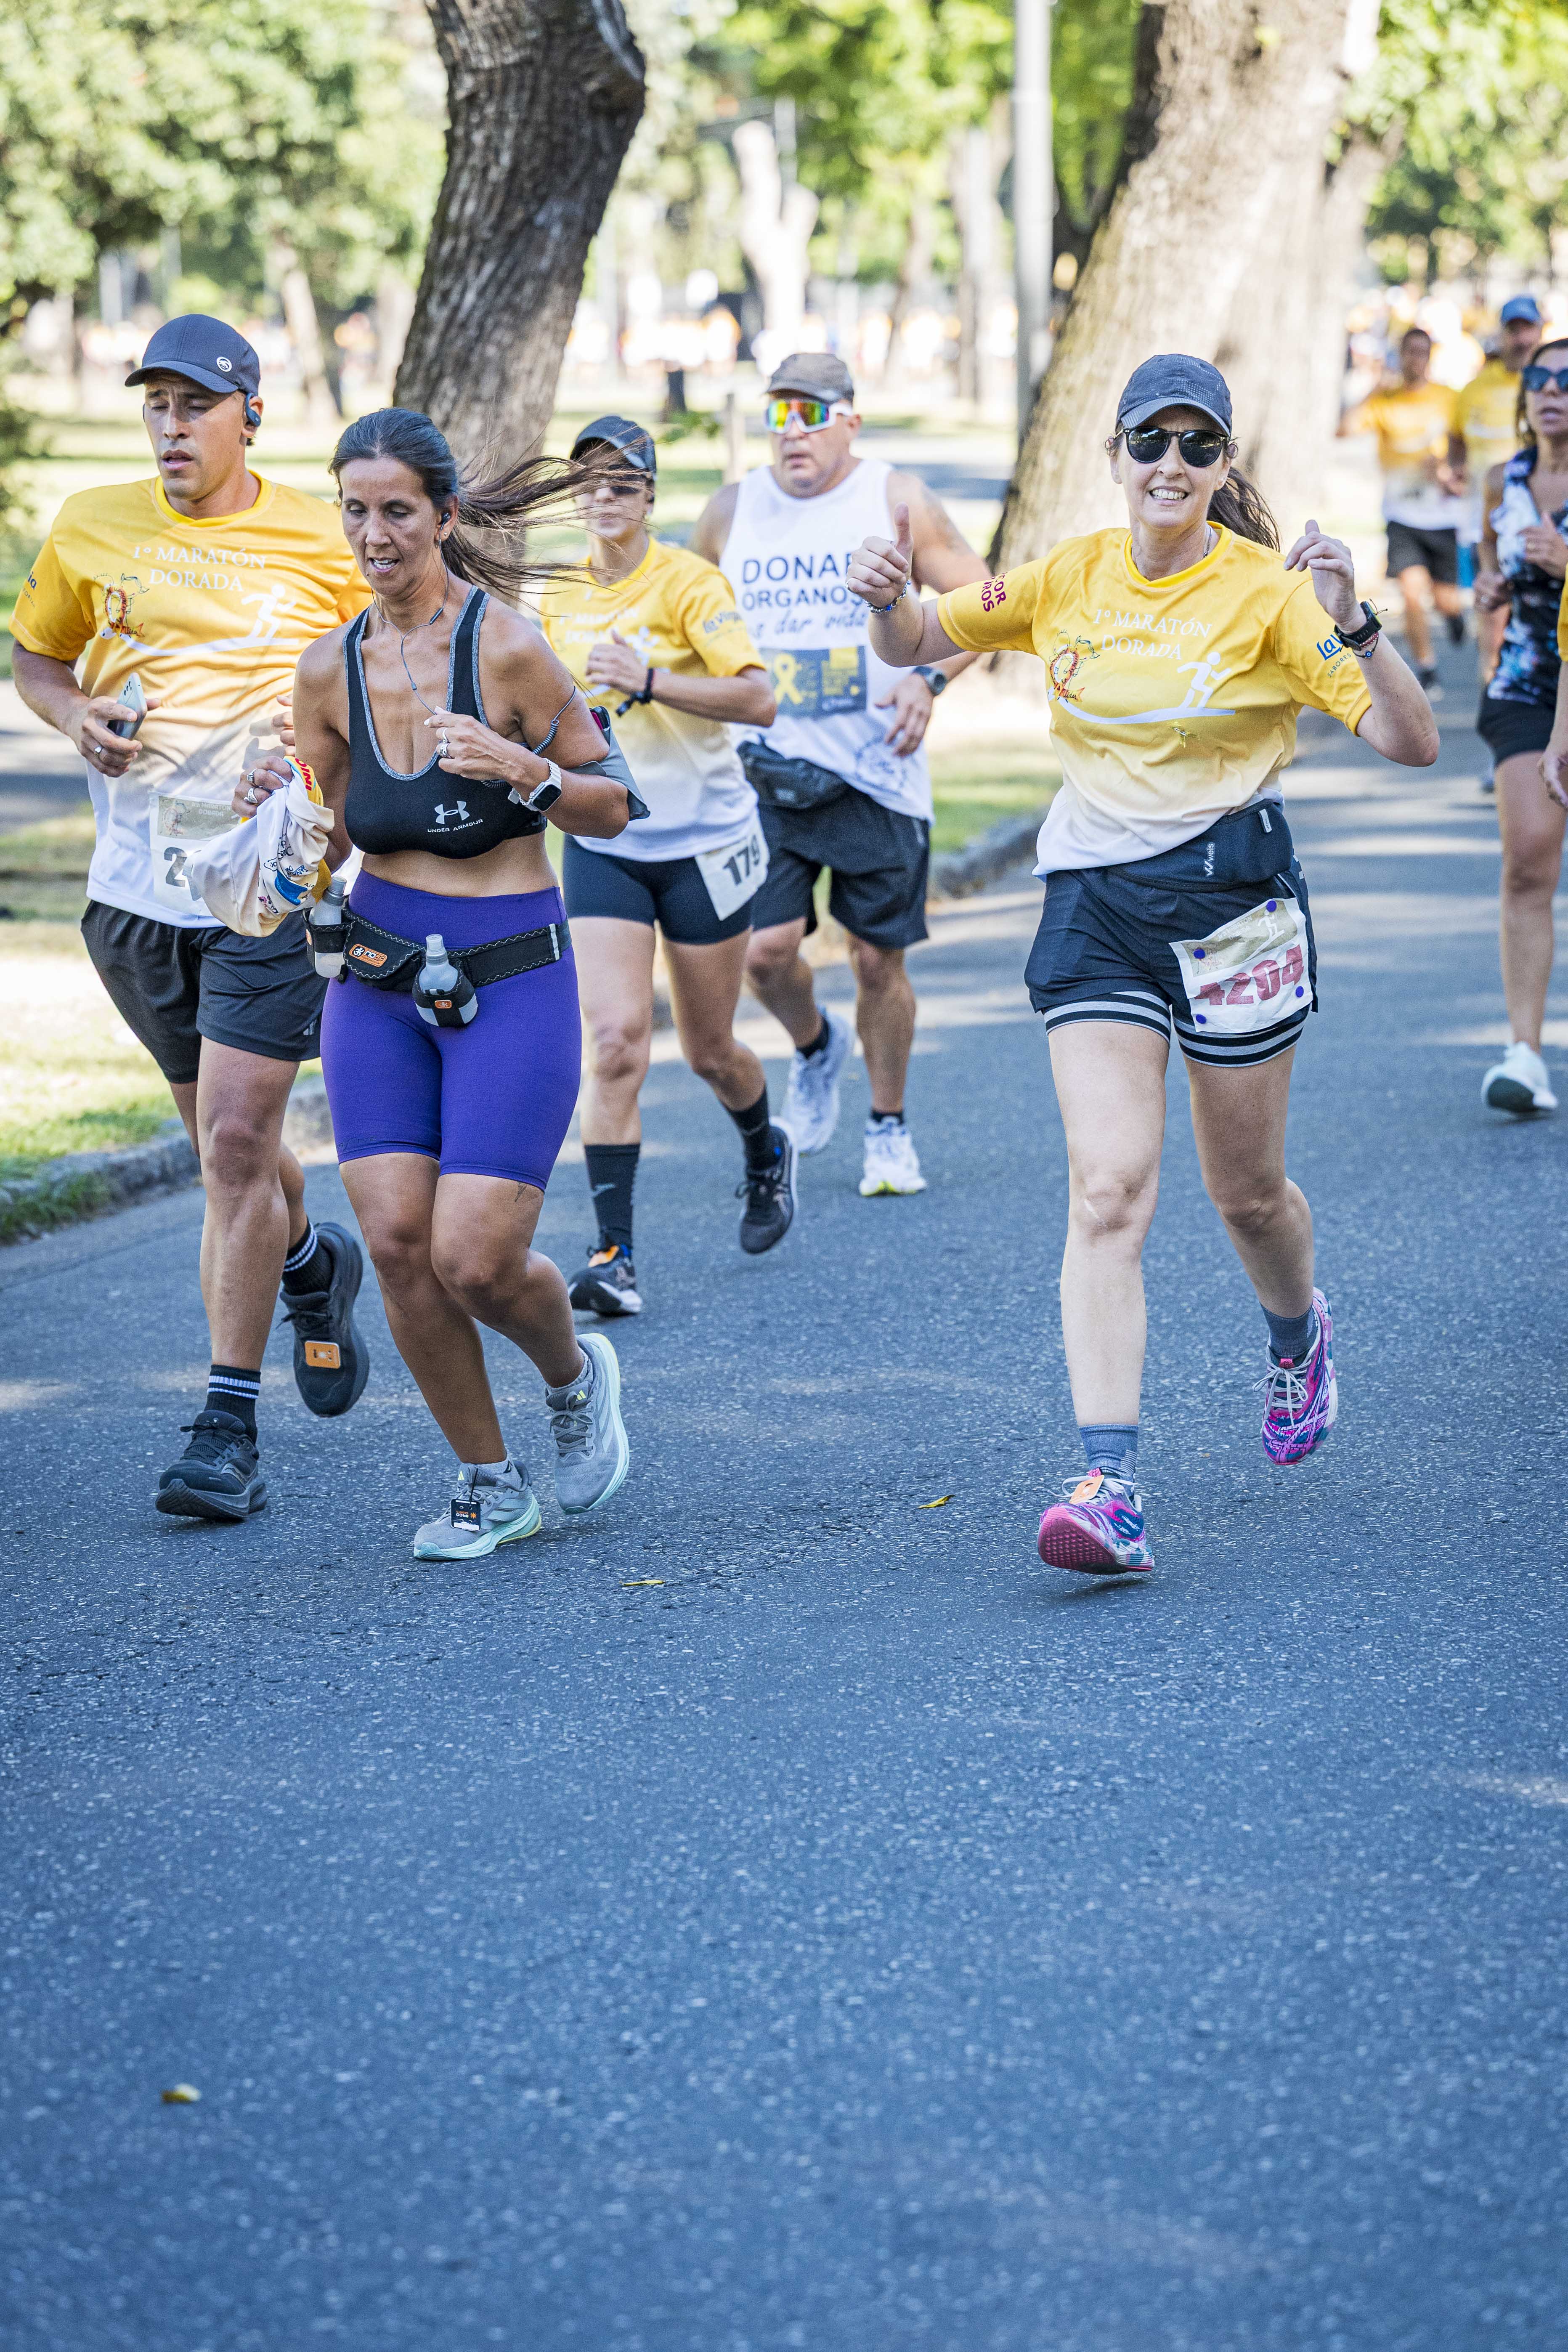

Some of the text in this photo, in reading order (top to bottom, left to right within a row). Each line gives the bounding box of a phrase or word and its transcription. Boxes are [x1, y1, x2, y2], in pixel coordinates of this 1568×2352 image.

[156, 547, 267, 569] MARATÓN
[149, 569, 244, 592] DORADA
[1112, 610, 1212, 638] MARATÓN
[1101, 634, 1182, 660] DORADA
[1327, 653, 1351, 678] SABORES
[453, 819, 483, 831] ARMOUR
[1194, 944, 1304, 1006] 4204
